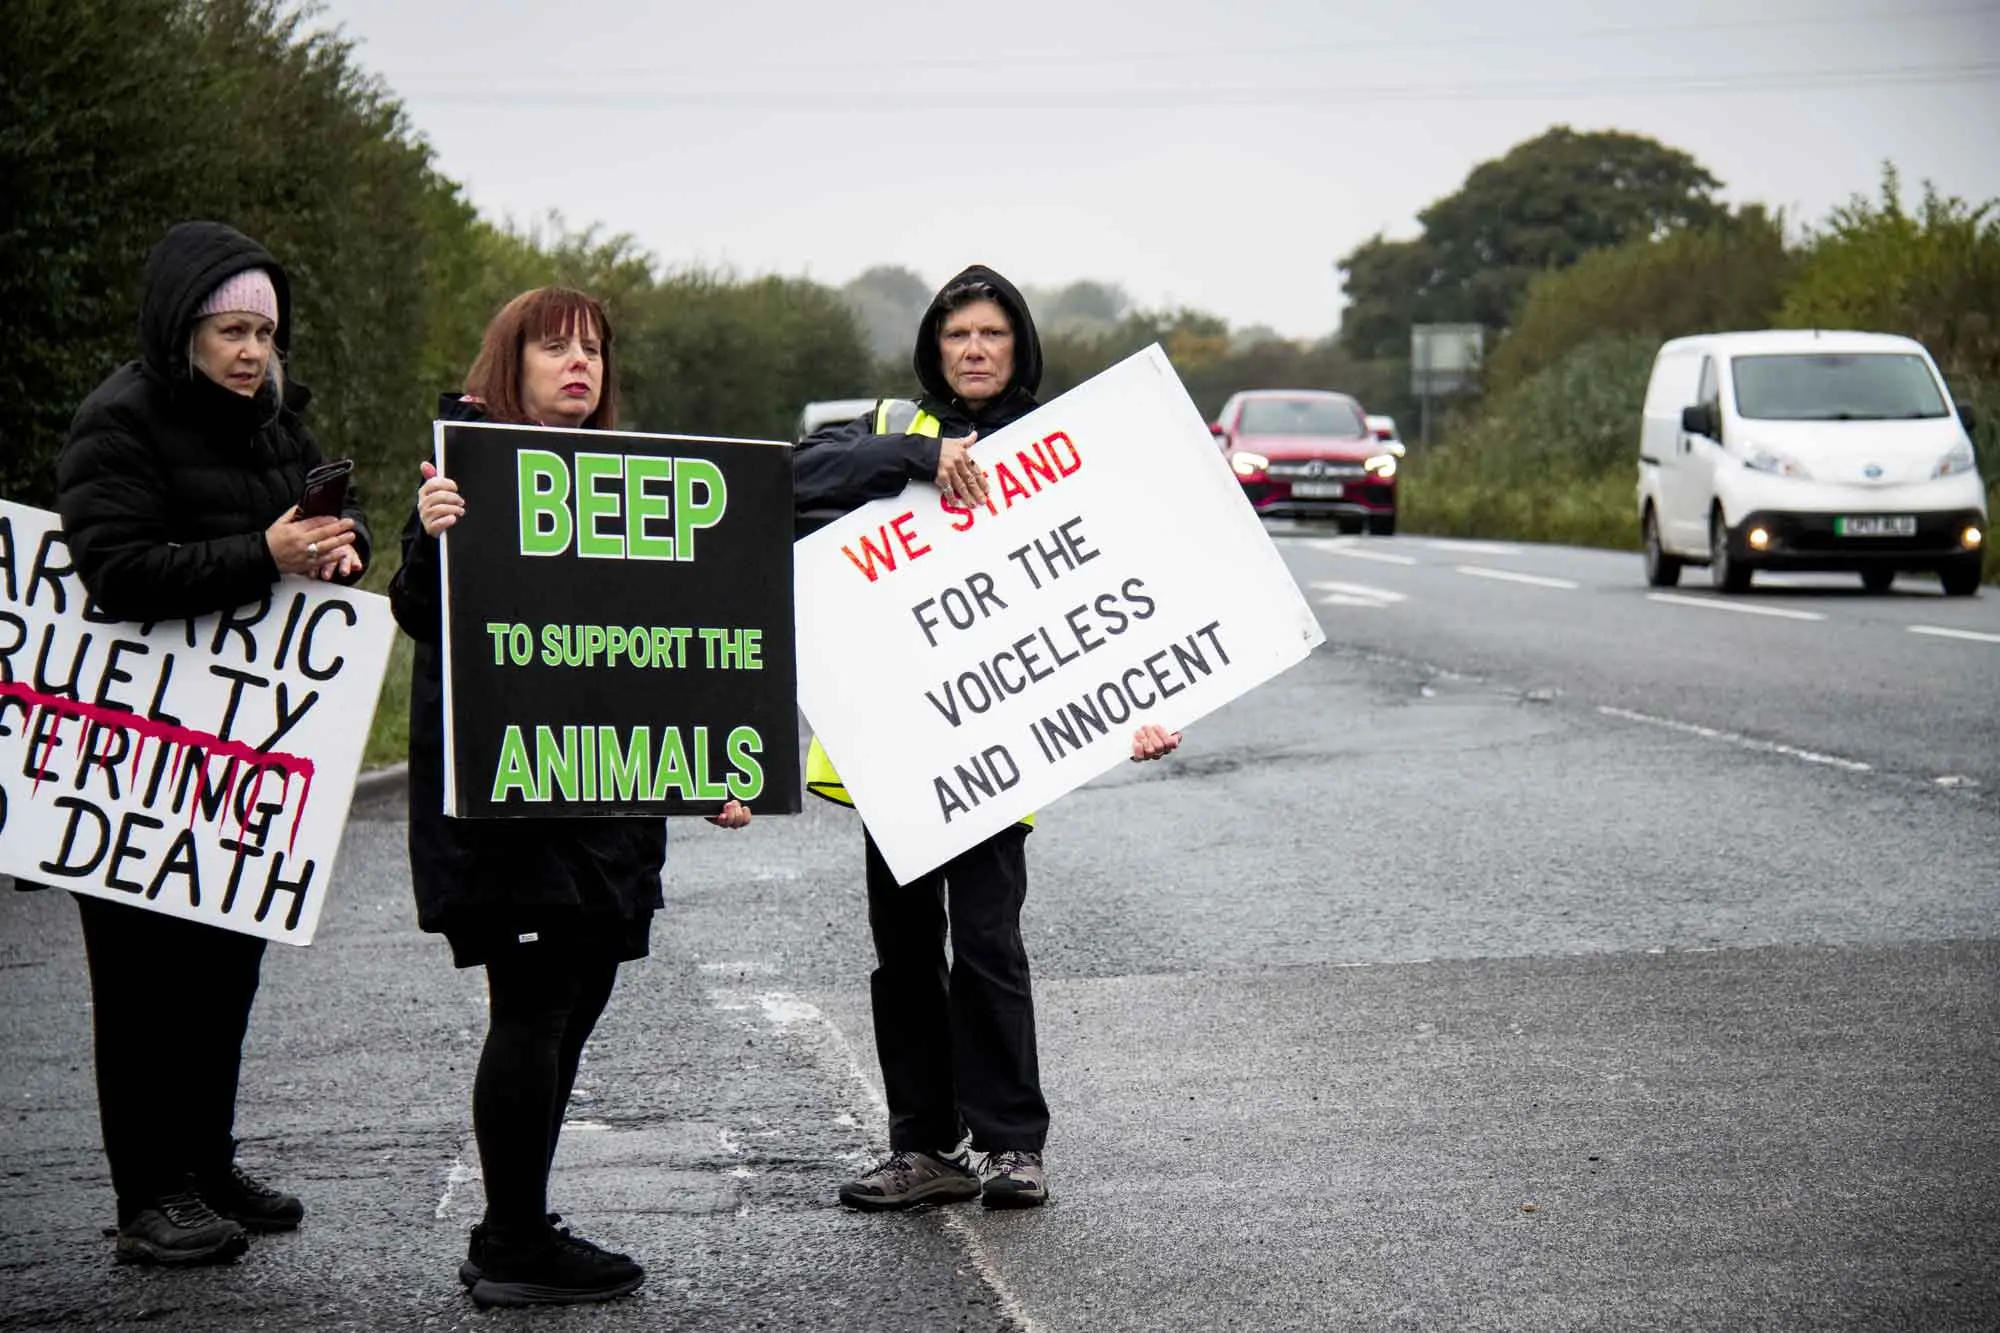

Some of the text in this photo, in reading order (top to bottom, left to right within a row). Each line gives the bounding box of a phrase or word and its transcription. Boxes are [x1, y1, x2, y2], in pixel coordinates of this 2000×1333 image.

[517, 448, 727, 561] BEEP
[841, 511, 931, 583] WE
[912, 516, 1100, 647] FOR THE
[487, 623, 763, 669] TO SUPPORT THE
[925, 578, 1155, 728] VOICELESS
[491, 725, 764, 802] ANIMALS
[932, 621, 1232, 824] AND INNOCENT
[39, 797, 315, 930] DEATH
